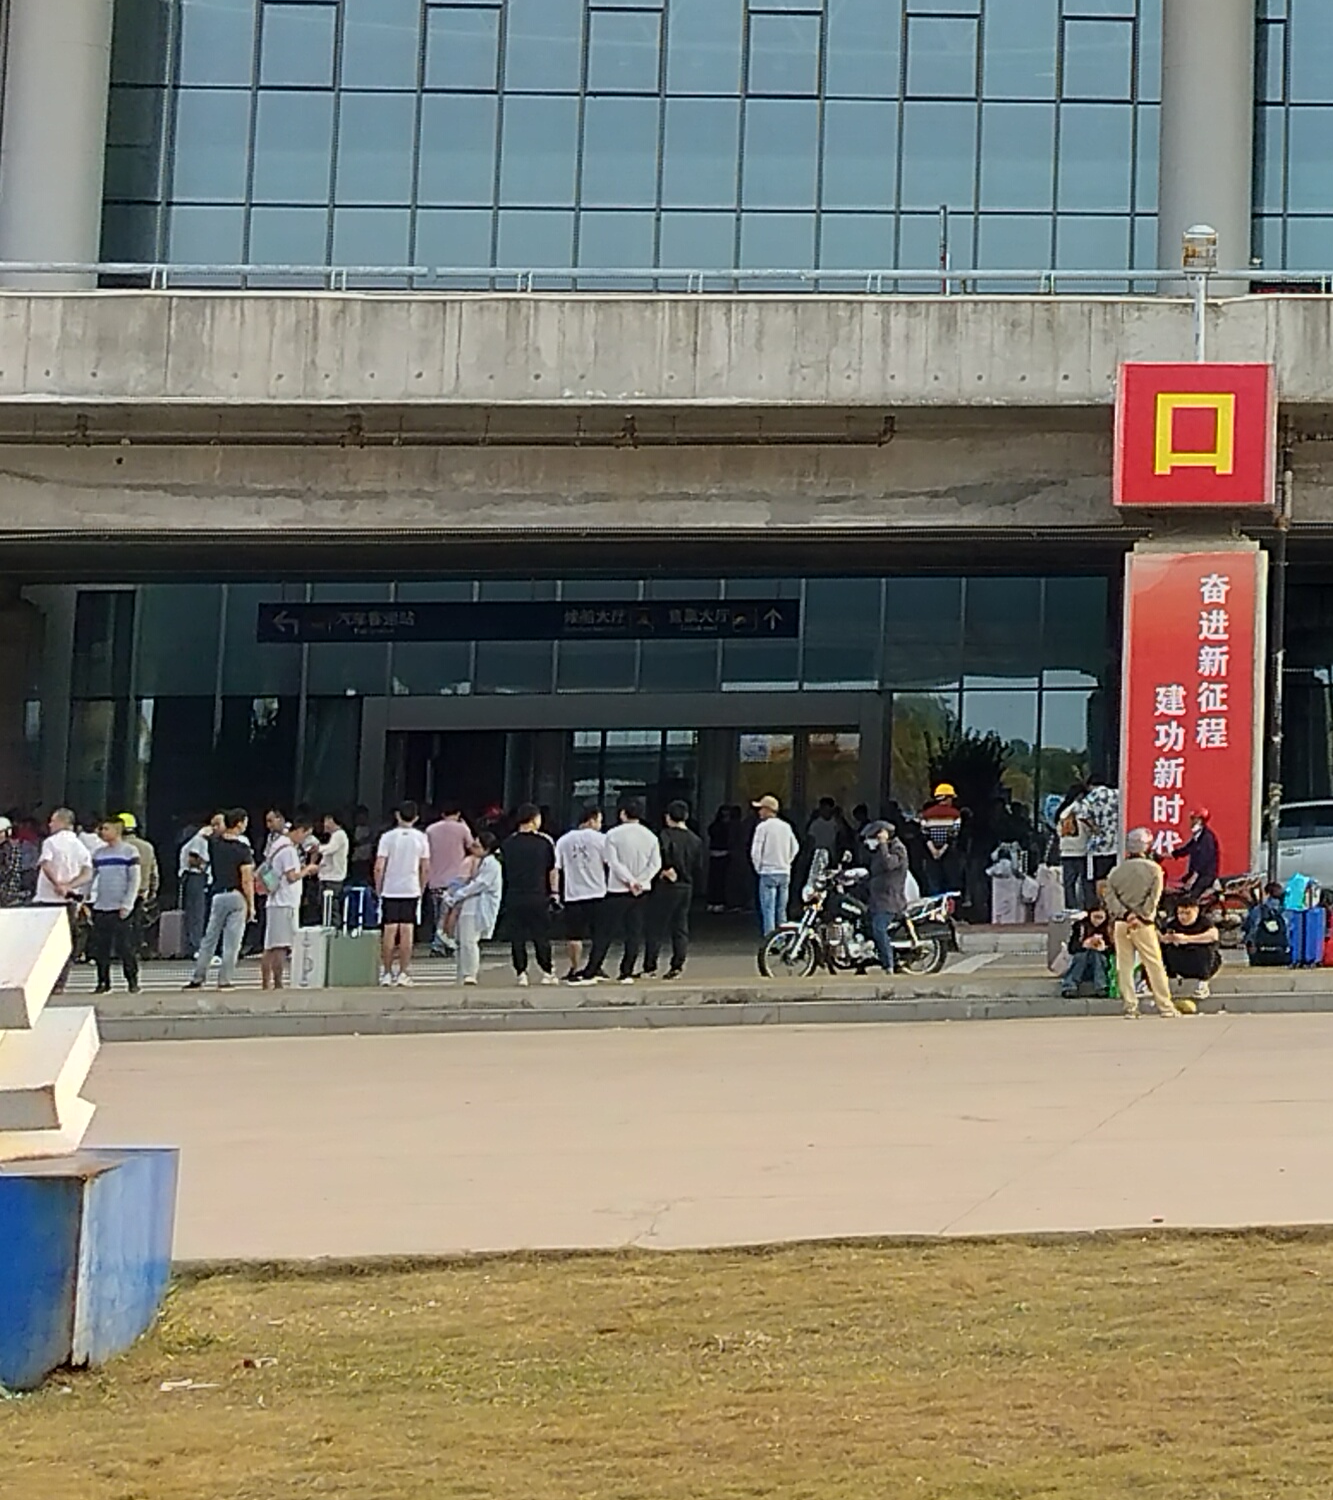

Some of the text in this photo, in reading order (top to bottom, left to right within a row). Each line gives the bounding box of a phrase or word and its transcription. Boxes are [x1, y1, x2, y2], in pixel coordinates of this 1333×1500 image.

[1154, 393, 1236, 475] 口
[1196, 574, 1230, 749] 奋进新征程
[1152, 685, 1187, 856] 建功新时代
